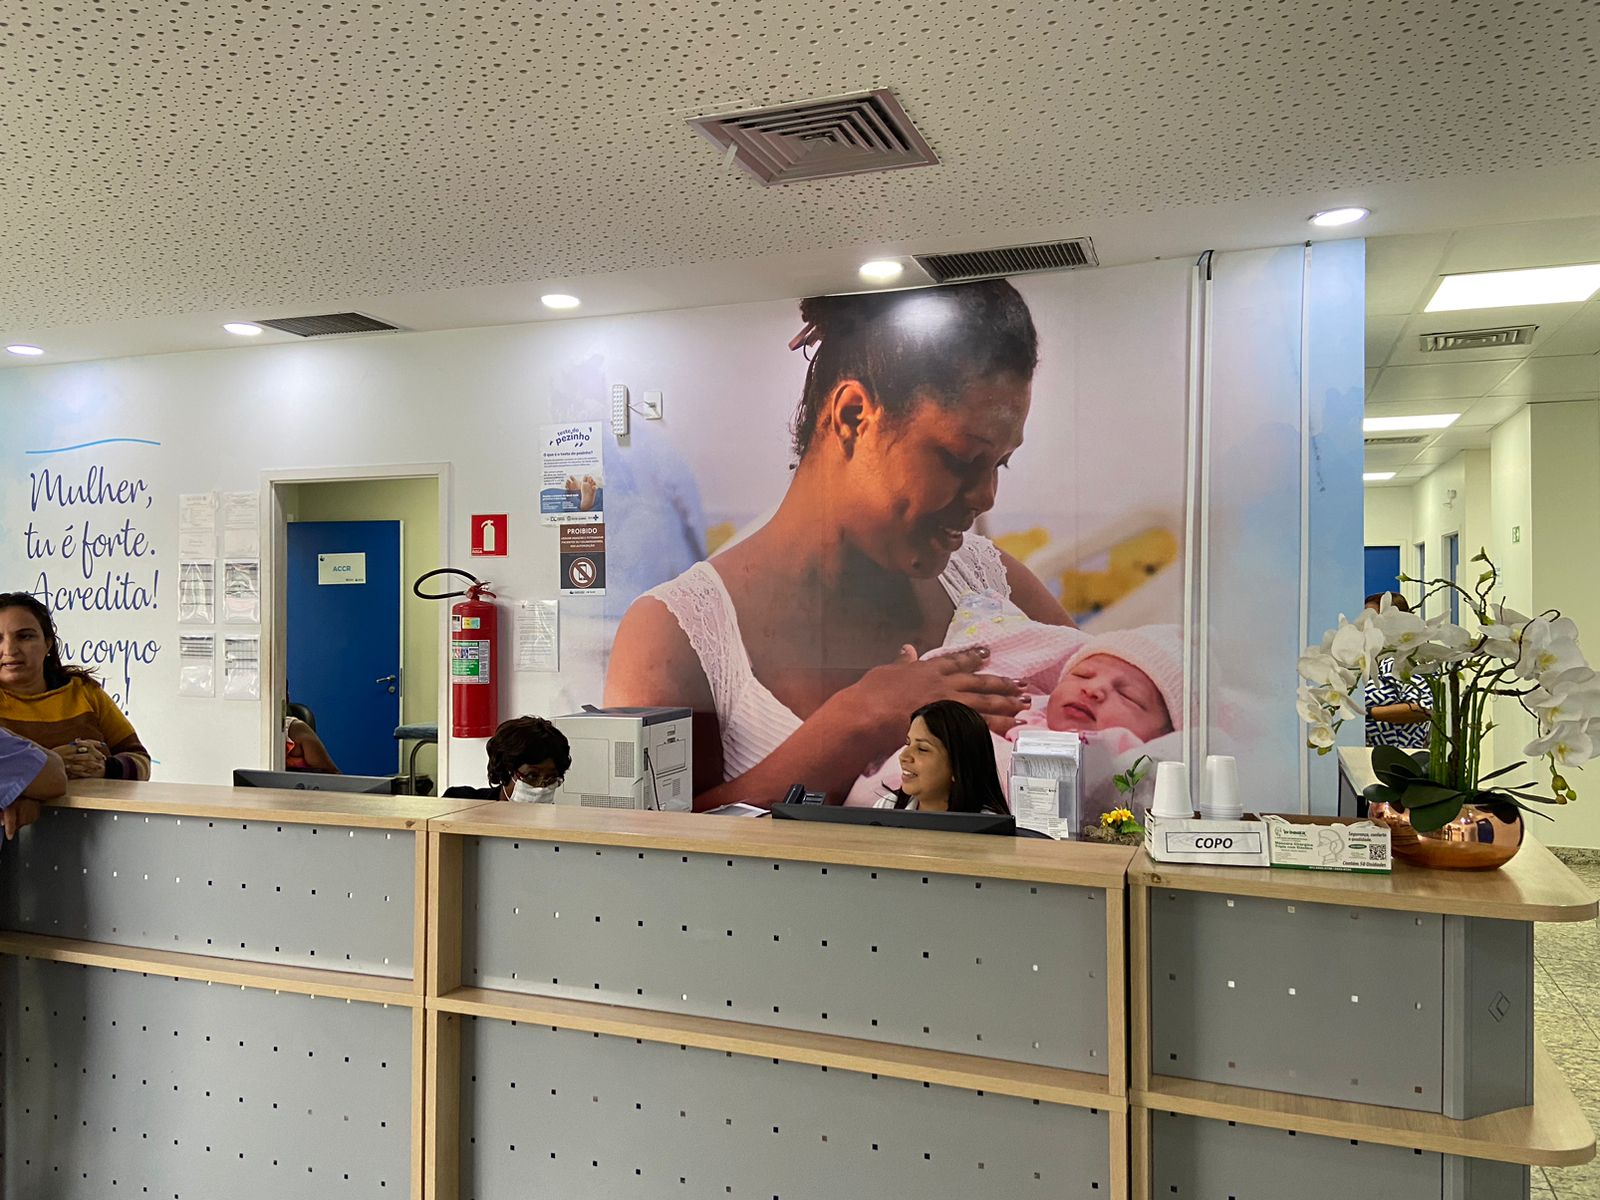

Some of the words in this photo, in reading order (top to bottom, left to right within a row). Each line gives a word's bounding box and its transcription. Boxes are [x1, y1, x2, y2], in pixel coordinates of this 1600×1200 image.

[555, 432, 590, 446] pezinho
[30, 465, 152, 512] Mulher,
[24, 522, 56, 559] tu
[62, 525, 76, 558] é
[82, 519, 155, 579] forte.
[26, 570, 158, 615] Acredita!
[81, 640, 161, 684] corpo
[1195, 838, 1233, 849] COPO
